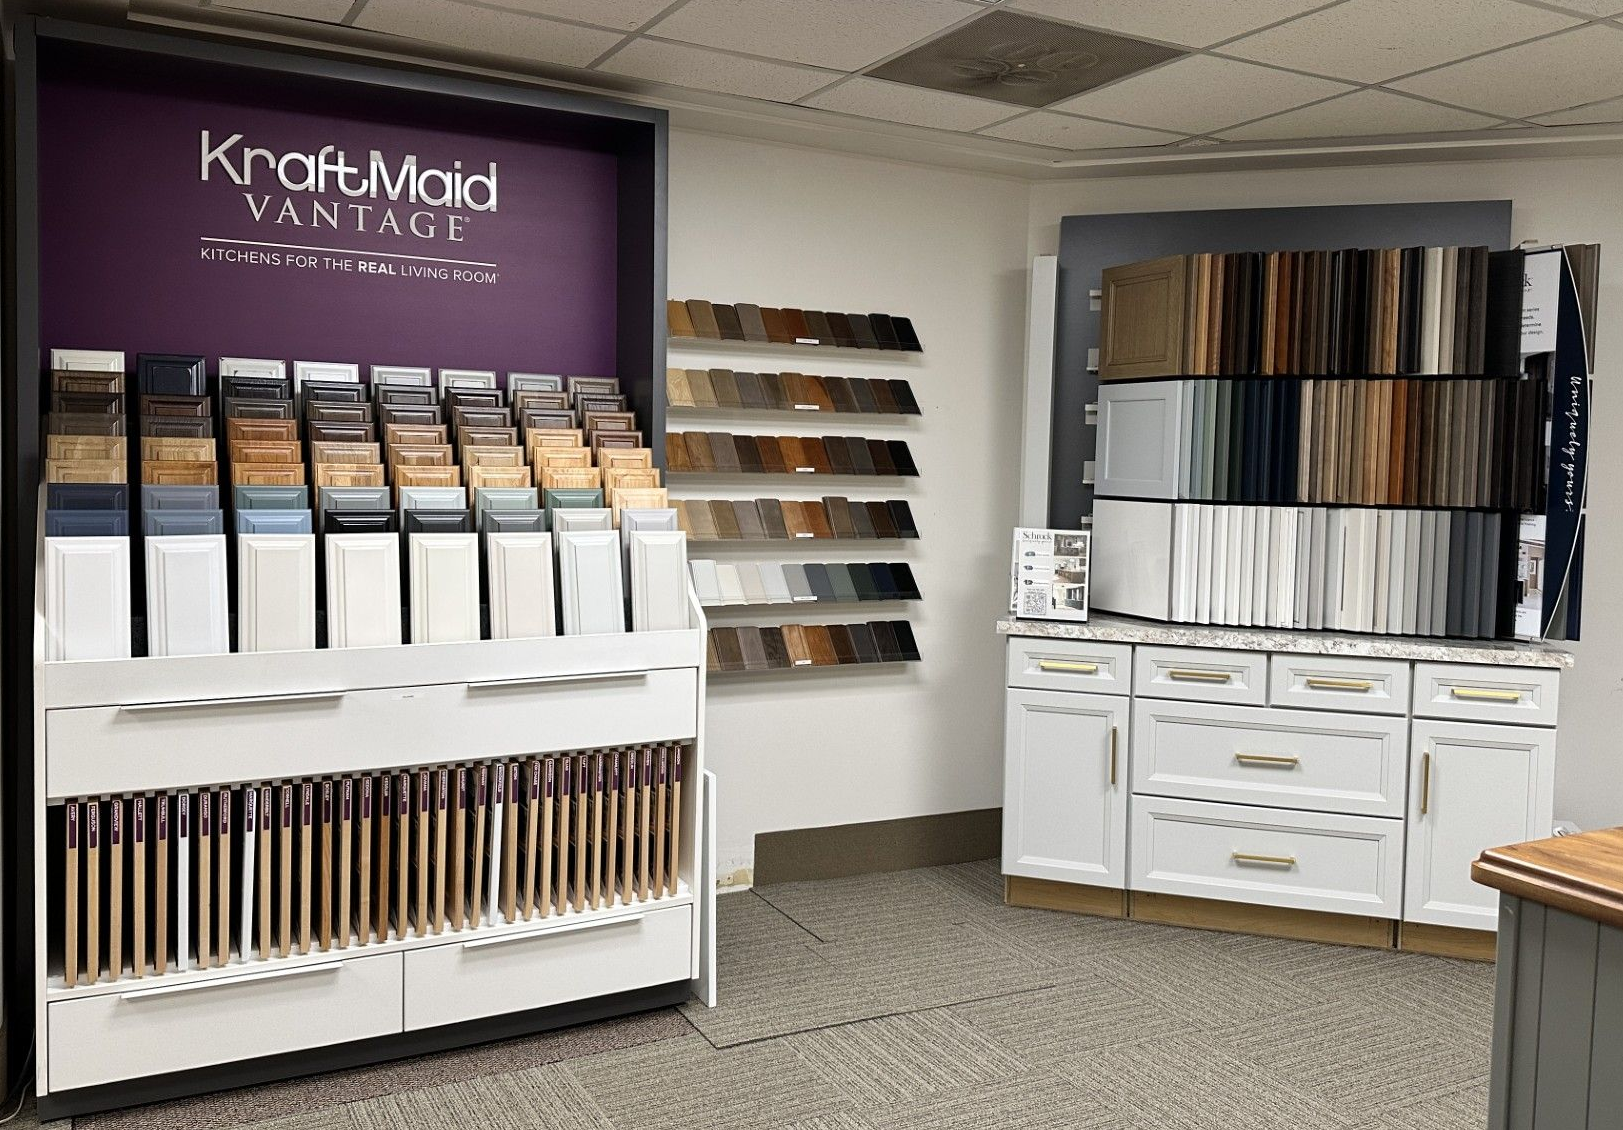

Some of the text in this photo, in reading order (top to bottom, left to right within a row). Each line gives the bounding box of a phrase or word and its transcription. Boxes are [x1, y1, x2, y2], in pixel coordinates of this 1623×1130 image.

[201, 129, 497, 212] KraftMaid
[200, 248, 496, 284] KITCHENS FOR THE REAL LIVING ROOM
[1562, 376, 1582, 461] Uniquely
